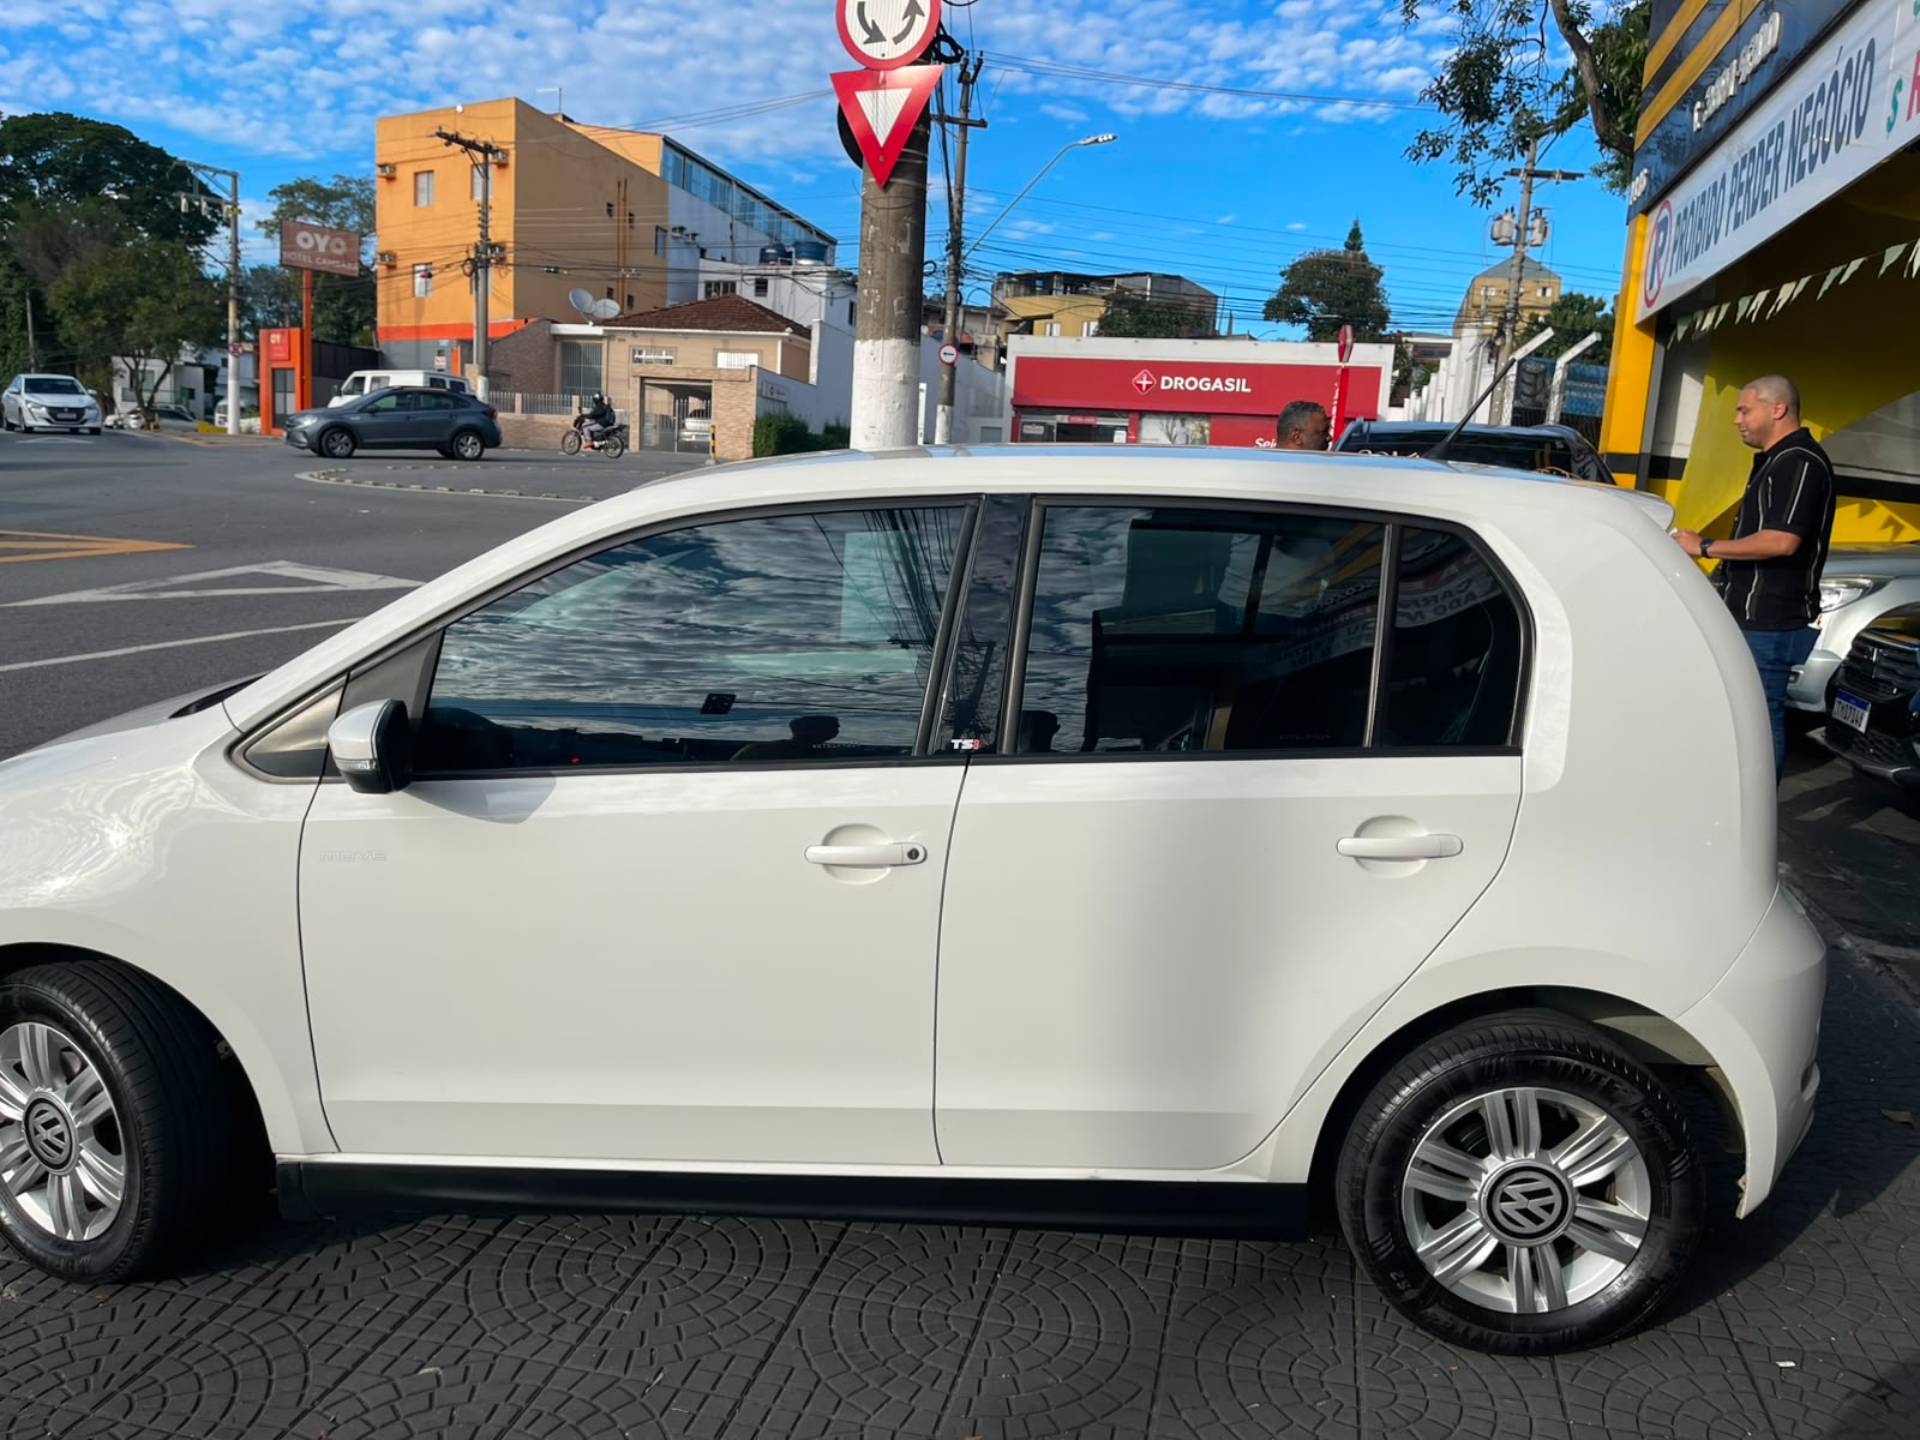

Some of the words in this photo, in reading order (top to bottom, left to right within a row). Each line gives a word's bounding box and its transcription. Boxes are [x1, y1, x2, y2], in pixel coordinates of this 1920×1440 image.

[1669, 171, 1727, 277] PROIBIDO
[1725, 119, 1785, 238] PERDER
[1784, 37, 1876, 193] NEGÓCIO
[296, 230, 347, 256] OYO
[1160, 376, 1252, 392] DROGASIL
